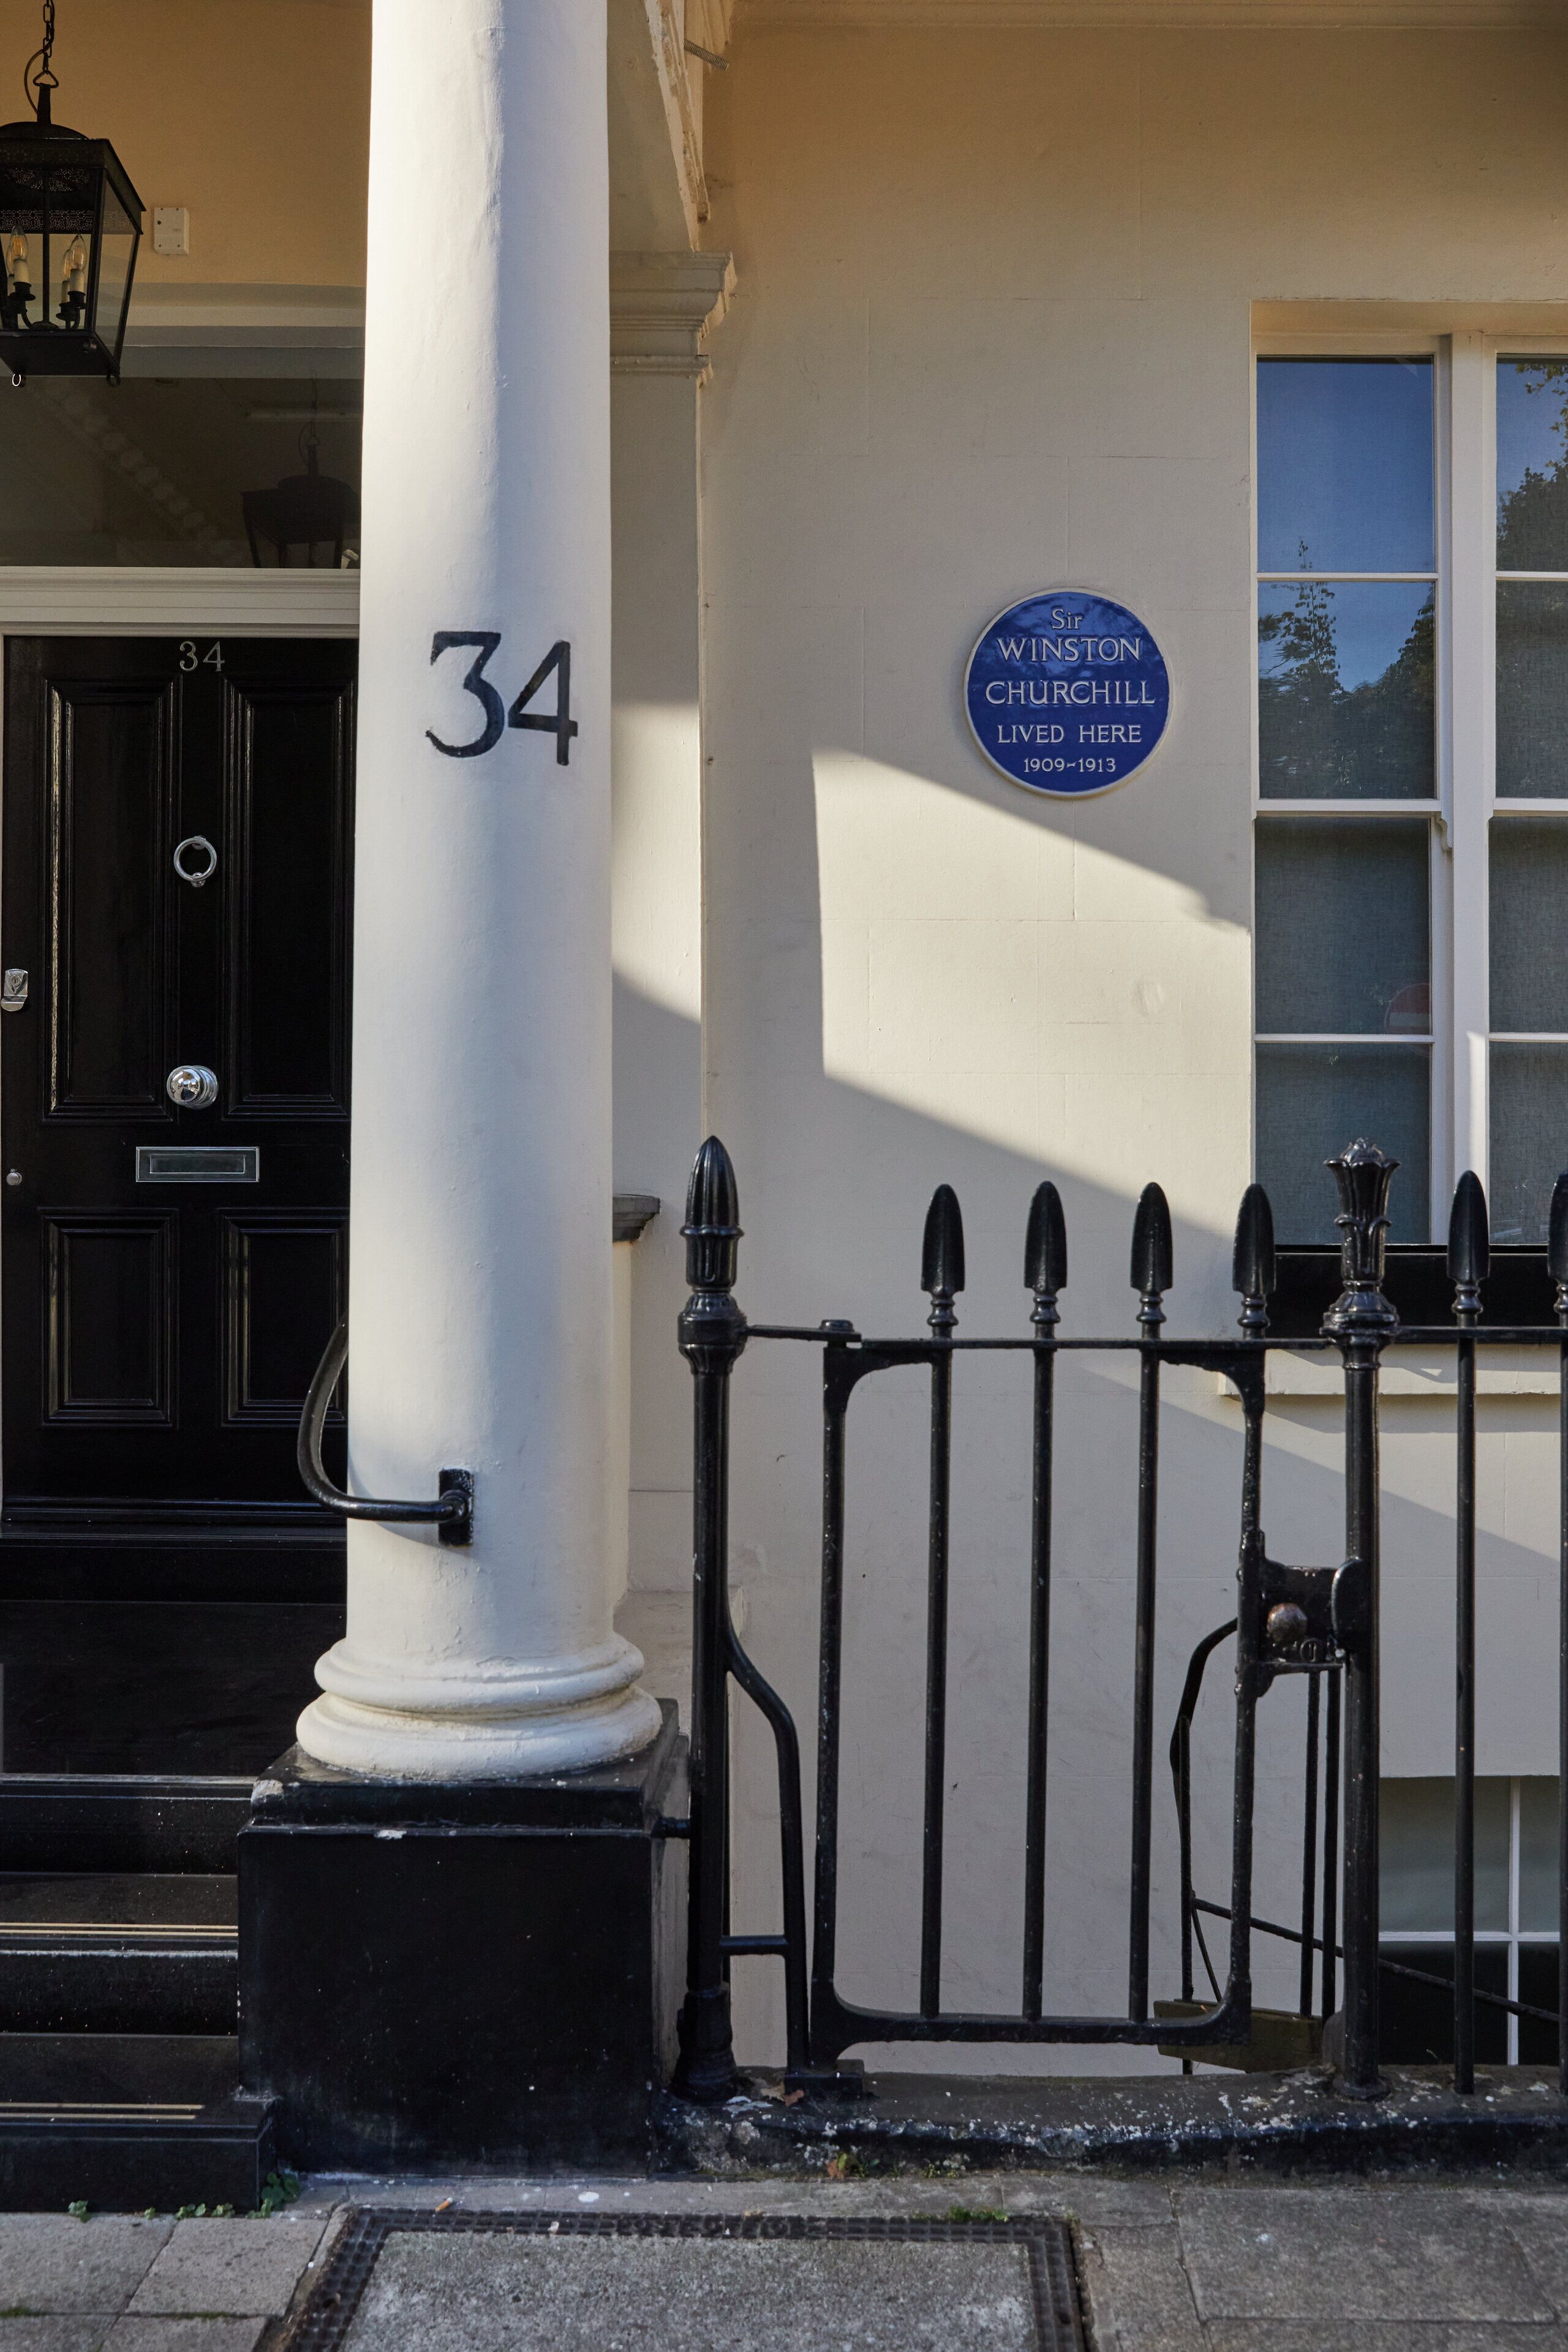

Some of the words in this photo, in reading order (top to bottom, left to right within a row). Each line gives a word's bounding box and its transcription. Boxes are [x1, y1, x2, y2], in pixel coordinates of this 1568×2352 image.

[1052, 609, 1082, 629] Sir
[179, 641, 225, 671] 34
[998, 638, 1141, 662] WINSTON
[425, 631, 578, 766] 34
[986, 680, 1155, 704] CHURCHILL
[998, 725, 1065, 743] LIVED
[1079, 725, 1142, 743] HERE
[1023, 759, 1116, 772] 1909-1913
